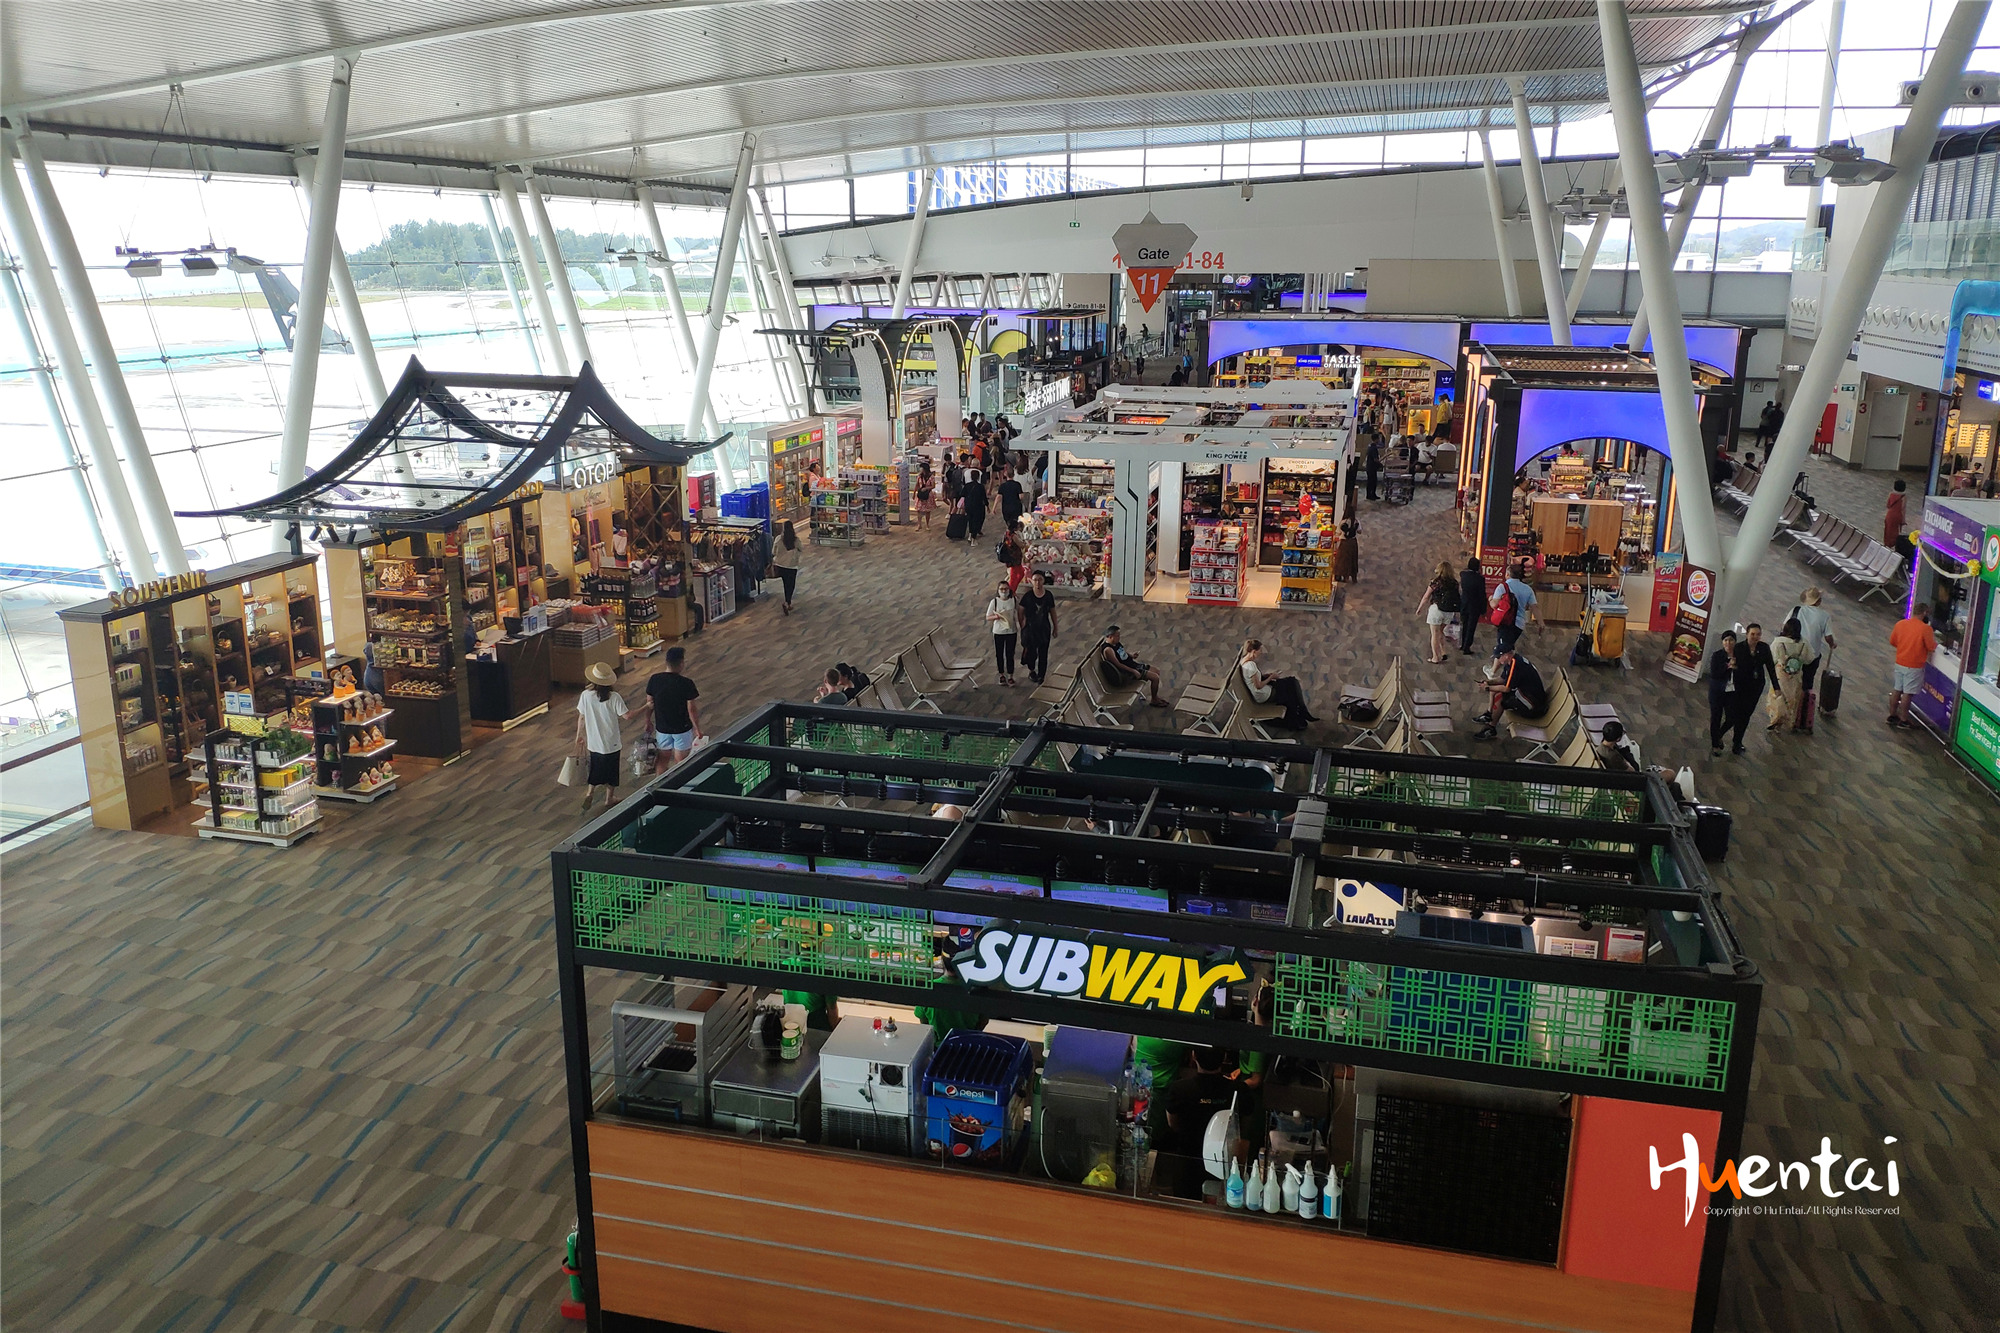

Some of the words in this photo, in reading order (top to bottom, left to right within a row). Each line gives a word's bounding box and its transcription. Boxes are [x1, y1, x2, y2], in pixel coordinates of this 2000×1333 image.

[1138, 248, 1170, 260] Gate
[1138, 273, 1160, 295] 11
[1324, 355, 1361, 364] TASTES
[1858, 403, 1867, 414] 3
[574, 462, 614, 489] OTOP
[1924, 509, 1954, 535] EXCHANGE
[1481, 565, 1503, 577] 10%
[1690, 579, 1707, 587] BURGER
[108, 569, 208, 612] SOUVENIR
[1690, 585, 1707, 595] KING
[1971, 711, 1980, 725] Best
[1980, 718, 1998, 739] Provider
[1116, 887, 1138, 895] EXTRA
[1346, 913, 1395, 927] LAVAZZA
[957, 930, 1247, 1014] SUBWAY
[959, 1088, 985, 1099] pepsi
